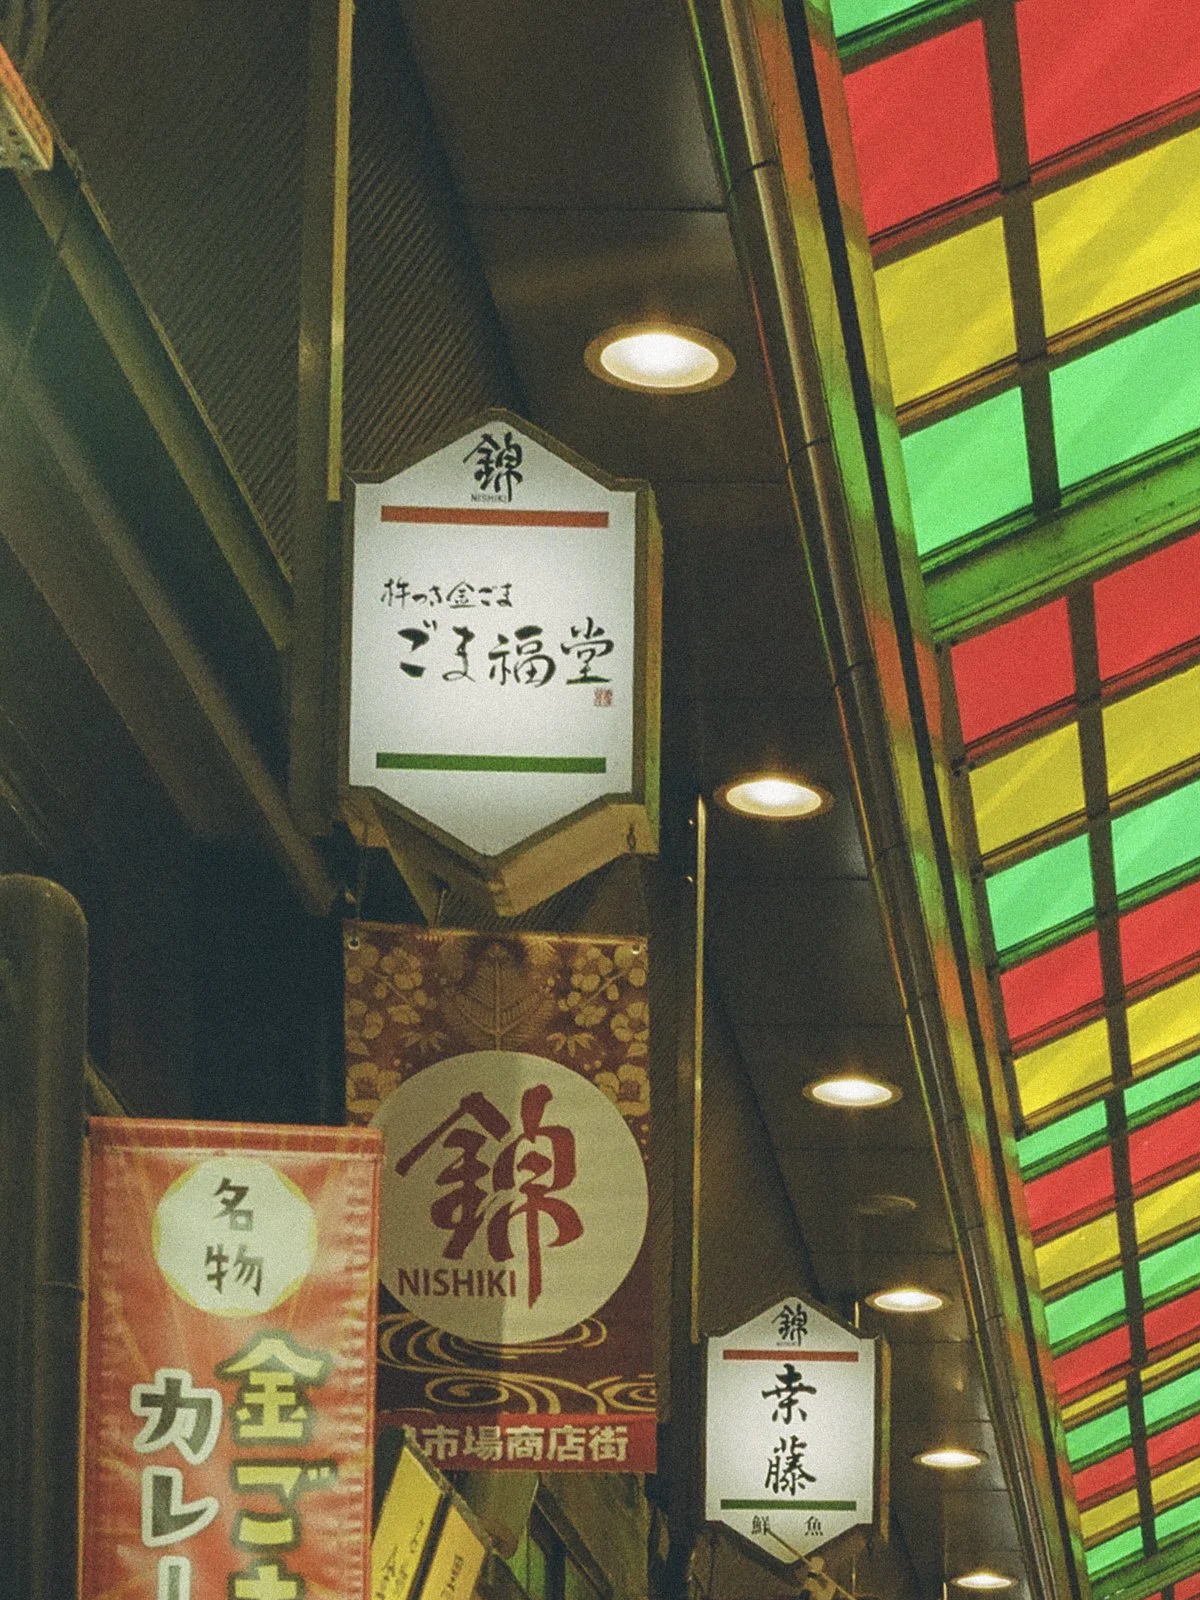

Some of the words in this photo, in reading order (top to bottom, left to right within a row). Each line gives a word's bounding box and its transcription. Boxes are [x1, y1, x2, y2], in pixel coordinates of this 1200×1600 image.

[463, 433, 523, 502] 錦
[381, 577, 514, 609] 杵つき金ごま
[397, 616, 615, 688] ごま福堂
[396, 1083, 584, 1310] 錦
[202, 1177, 265, 1296] 名物
[398, 1268, 517, 1299] NISHIKI
[771, 1303, 809, 1347] 錦
[751, 1515, 824, 1536] 鮮魚
